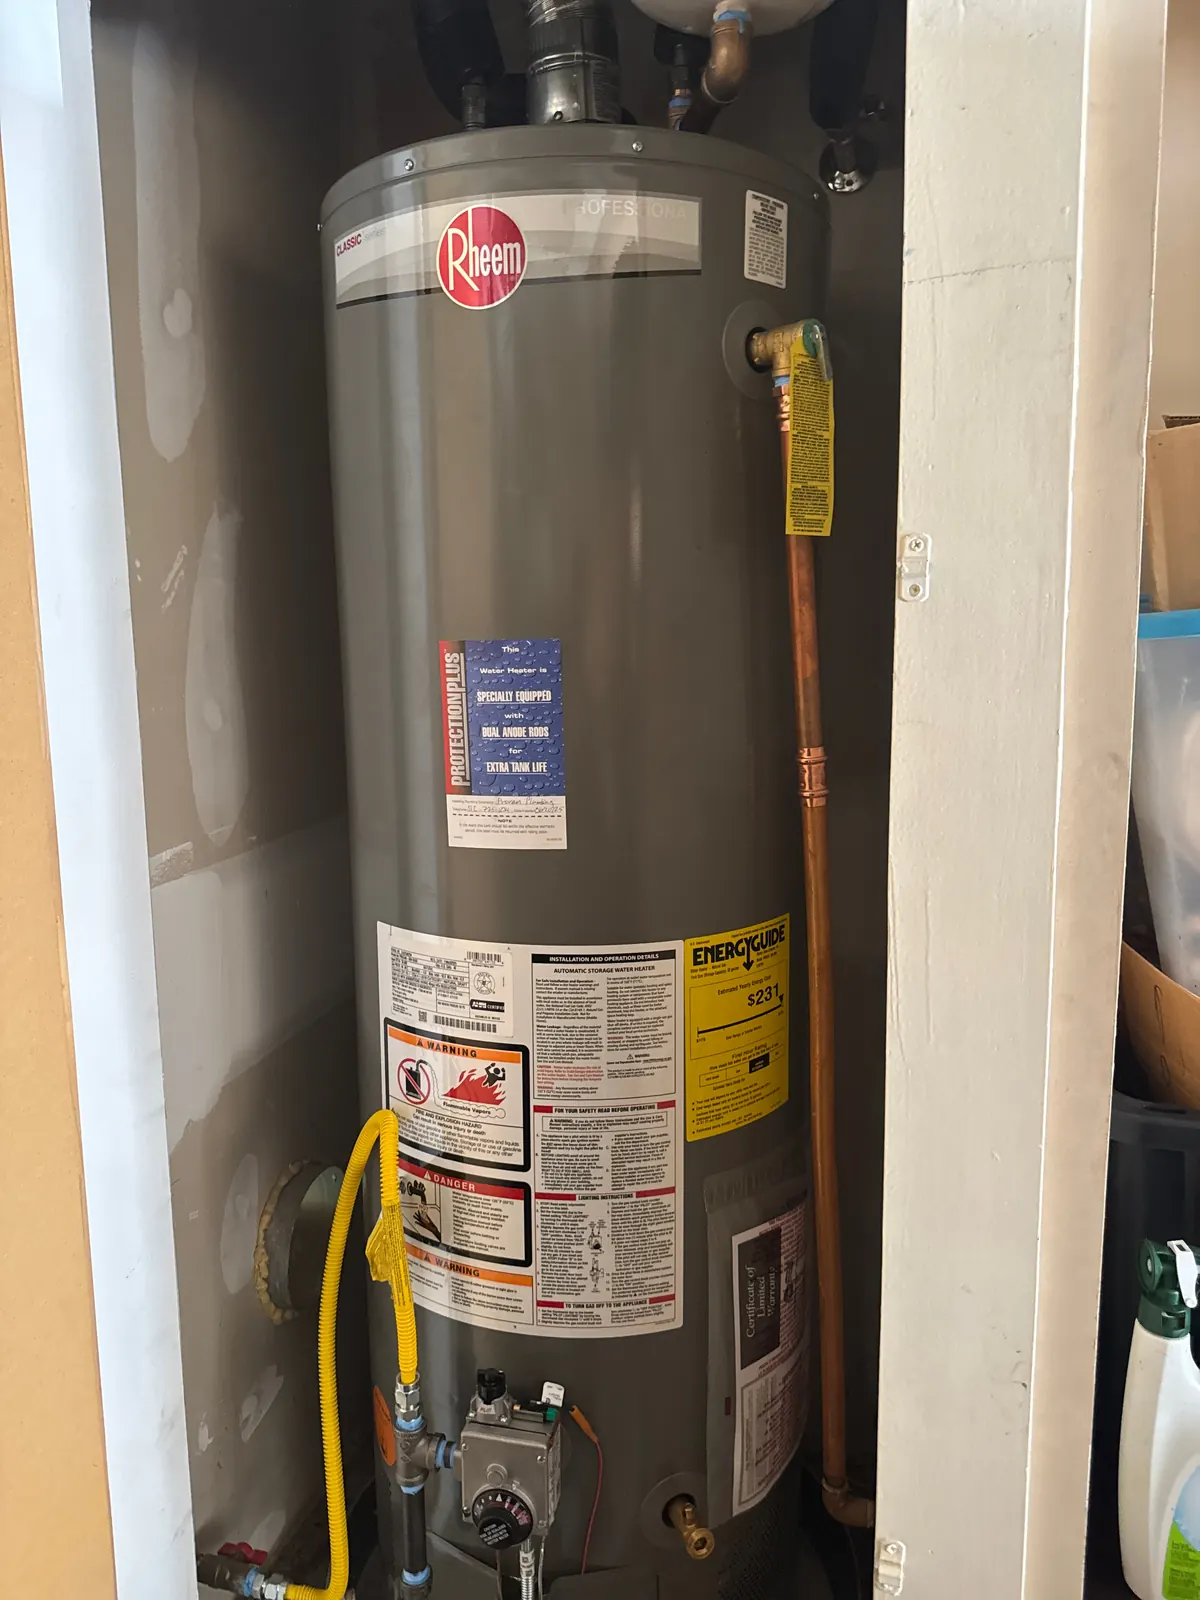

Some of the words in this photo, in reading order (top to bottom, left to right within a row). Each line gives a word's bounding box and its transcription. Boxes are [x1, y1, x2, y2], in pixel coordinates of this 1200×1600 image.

[337, 234, 362, 256] CLASSIC
[448, 208, 522, 290] Rheem
[477, 691, 513, 702] SPECIALLY
[516, 690, 551, 703] EQUIPPED
[482, 727, 500, 737] DUAL
[503, 727, 526, 737] ANODE
[529, 727, 549, 737] RODS
[487, 762, 509, 772] EXTRA
[511, 762, 530, 772] TANK
[533, 762, 547, 772] LIFE
[693, 924, 785, 967] ENERGYGUIDE
[718, 985, 738, 995] Estimated
[752, 978, 763, 986] Energy
[747, 983, 779, 1006] $231
[427, 1041, 477, 1058] WARNING
[754, 1042, 767, 1051] Rating
[443, 1101, 470, 1112] Flammable
[472, 1107, 491, 1115] Vapors
[435, 1114, 461, 1125] EXPLOSION
[462, 1120, 482, 1129] HAZARD
[437, 1121, 452, 1129] serious
[426, 1125, 440, 1133] gasoline
[457, 1133, 478, 1141] flammable
[460, 1139, 476, 1147] Storage
[434, 1174, 475, 1191] DANGER
[436, 1258, 479, 1277] WARNING
[745, 1265, 756, 1278] of
[756, 1276, 765, 1318] Limited
[746, 1280, 756, 1338] Certificate
[483, 1524, 497, 1532] CAUTION
